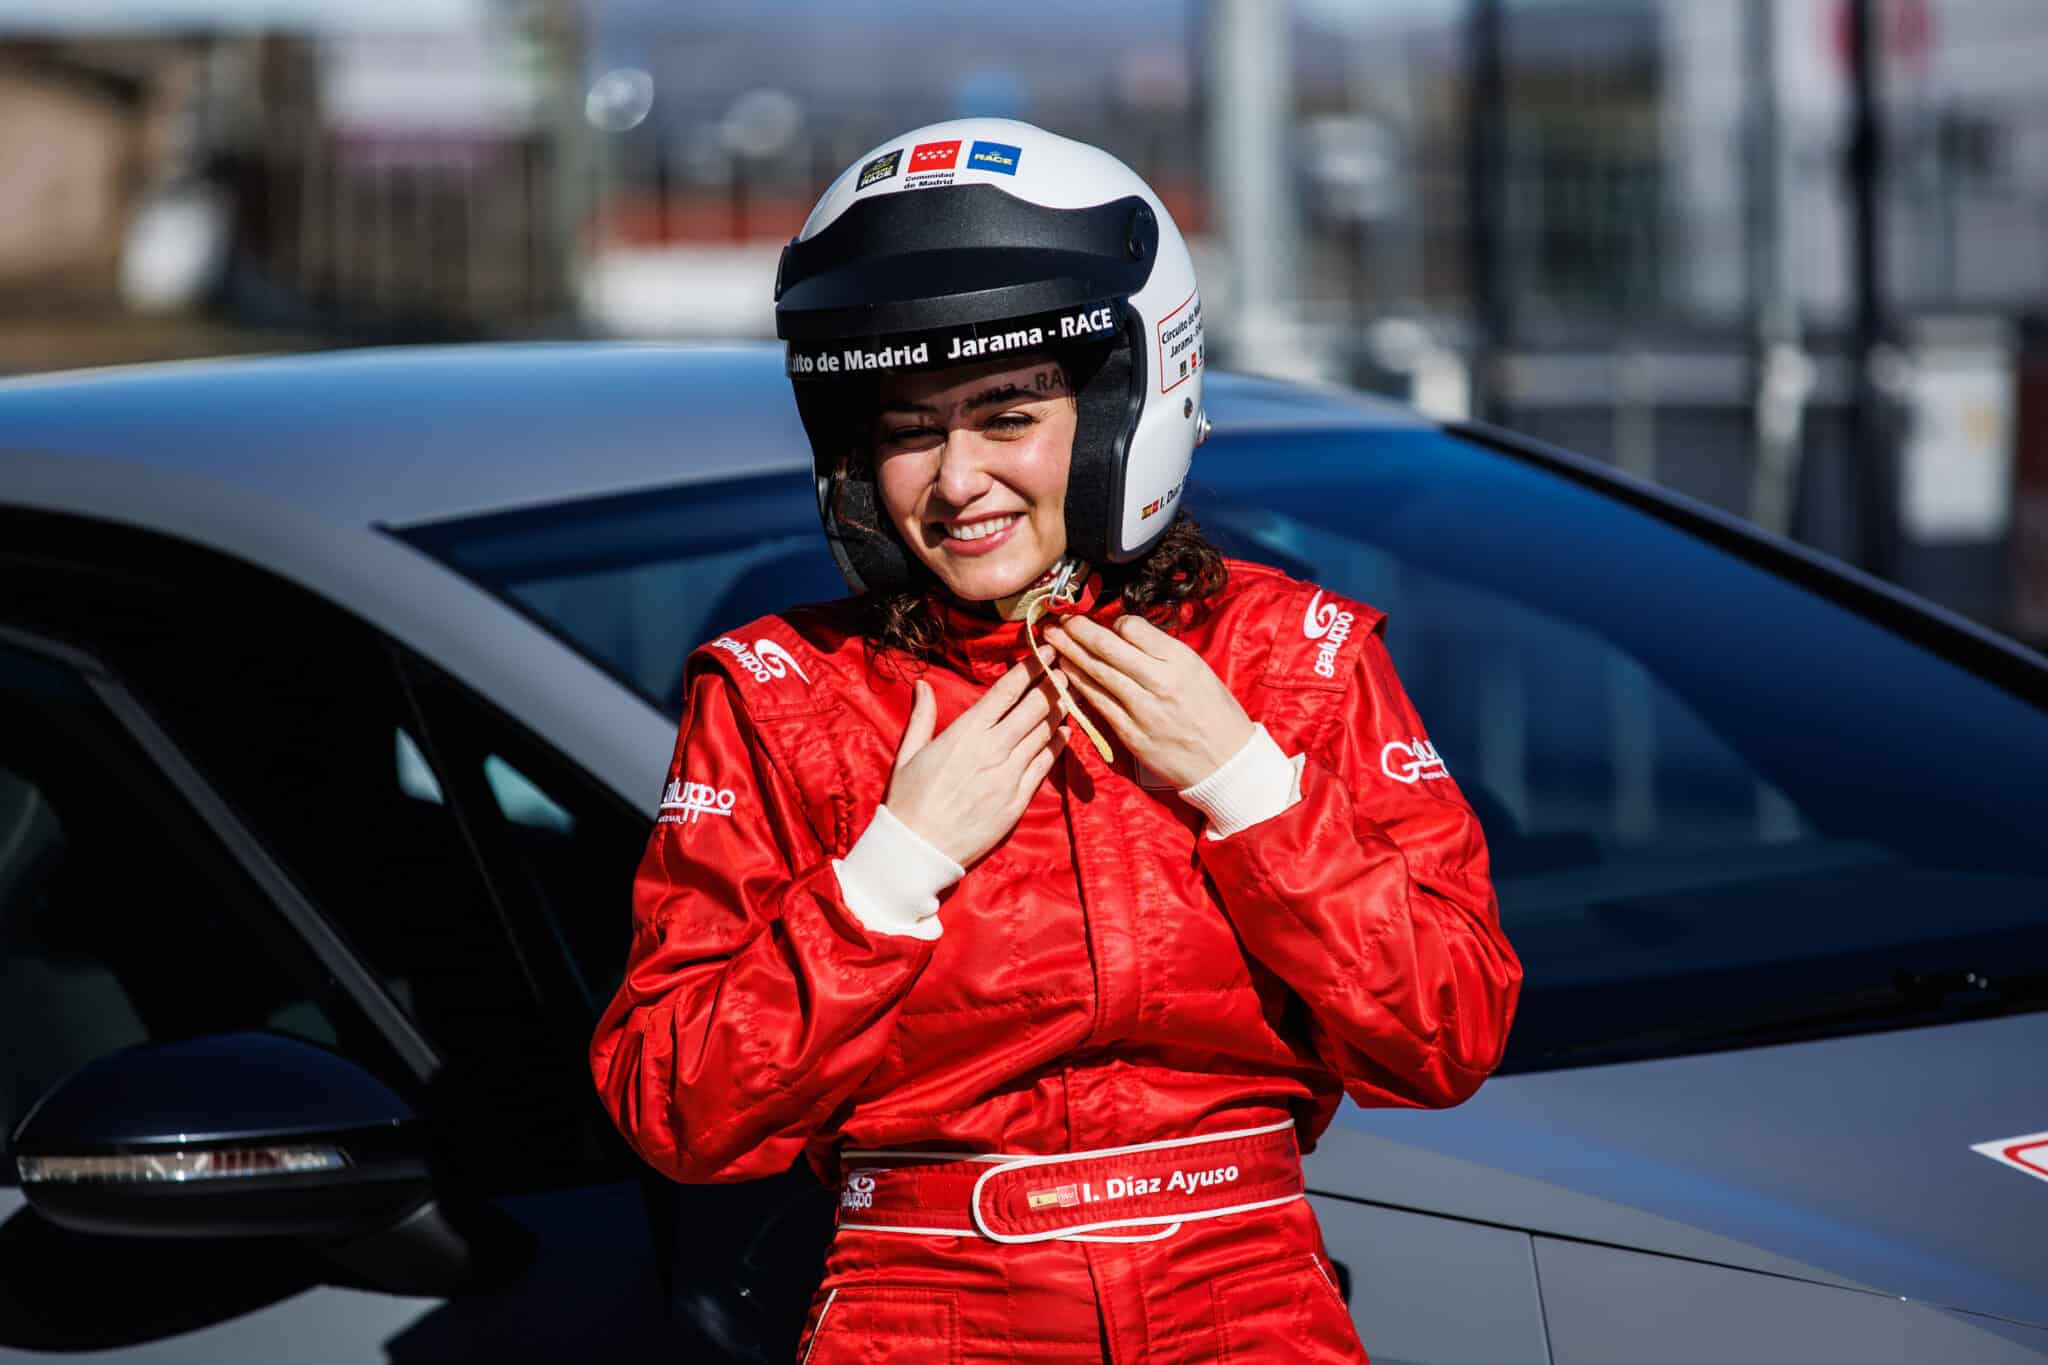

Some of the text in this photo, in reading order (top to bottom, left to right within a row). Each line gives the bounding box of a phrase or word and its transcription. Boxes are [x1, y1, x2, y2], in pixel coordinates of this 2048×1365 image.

[973, 153, 1014, 166] RACE
[904, 171, 955, 182] Comunidad
[918, 179, 953, 187] Madrid
[816, 352, 840, 373] de
[843, 342, 929, 371] Madrid
[947, 327, 1043, 360] Jarama
[1060, 307, 1113, 338] RACE
[1161, 319, 1188, 345] Circuito
[1313, 611, 1355, 678] galuppo
[1083, 1183, 1100, 1203] I.
[1166, 1165, 1239, 1195] Ayuso
